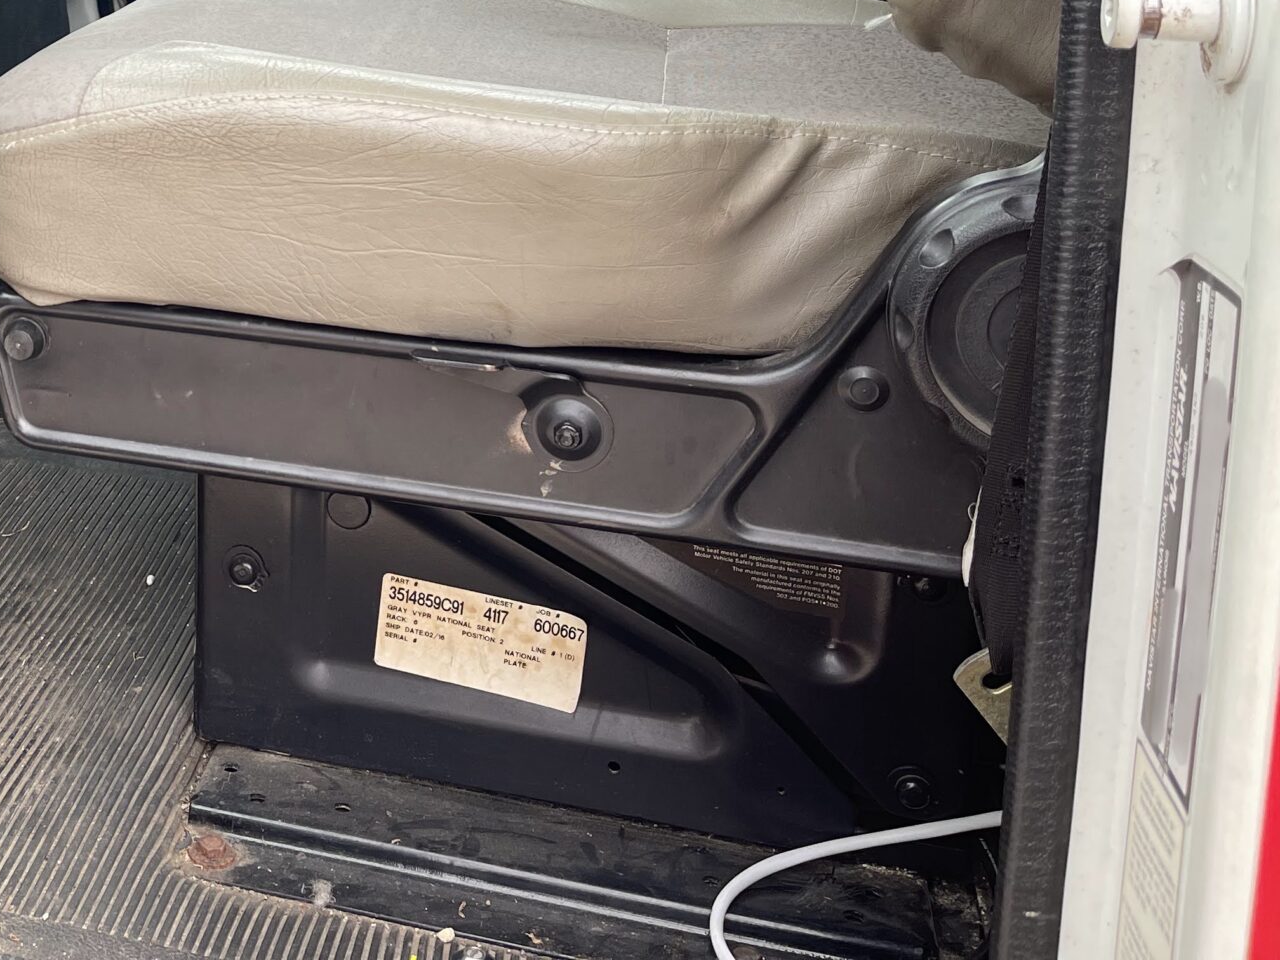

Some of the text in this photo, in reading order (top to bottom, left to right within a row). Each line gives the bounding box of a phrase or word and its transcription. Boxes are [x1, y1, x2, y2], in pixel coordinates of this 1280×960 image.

[1169, 366, 1187, 513] NAVISTAR
[1146, 615, 1158, 691] NAVISTAR
[1153, 494, 1169, 614] INTERNATIONAL
[1164, 349, 1181, 486] TRANSPORTATION
[693, 544, 705, 552] This
[748, 554, 779, 564] applicable
[780, 560, 819, 571] requirements
[828, 567, 842, 575] DOT
[694, 551, 711, 559] Motor
[713, 554, 734, 563] Vehicle
[735, 558, 754, 566] Safety
[755, 561, 786, 571] Standards
[390, 575, 410, 585] PART
[744, 568, 769, 577] material
[750, 576, 792, 587] manufactured
[755, 583, 795, 594] requirements
[388, 585, 465, 615] 3514859C91
[485, 597, 514, 609] LINESET
[387, 604, 407, 614] GRAY
[436, 615, 472, 628] NATIONAL
[477, 624, 495, 633] SEAT
[483, 607, 509, 625] 4117
[536, 609, 551, 617] JOB
[384, 631, 408, 642] SERIAL
[533, 618, 585, 642] 600667
[385, 622, 401, 630] SHIP
[531, 646, 547, 655] LINE
[503, 658, 527, 669] PLATE
[504, 649, 540, 663] NATIONAL
